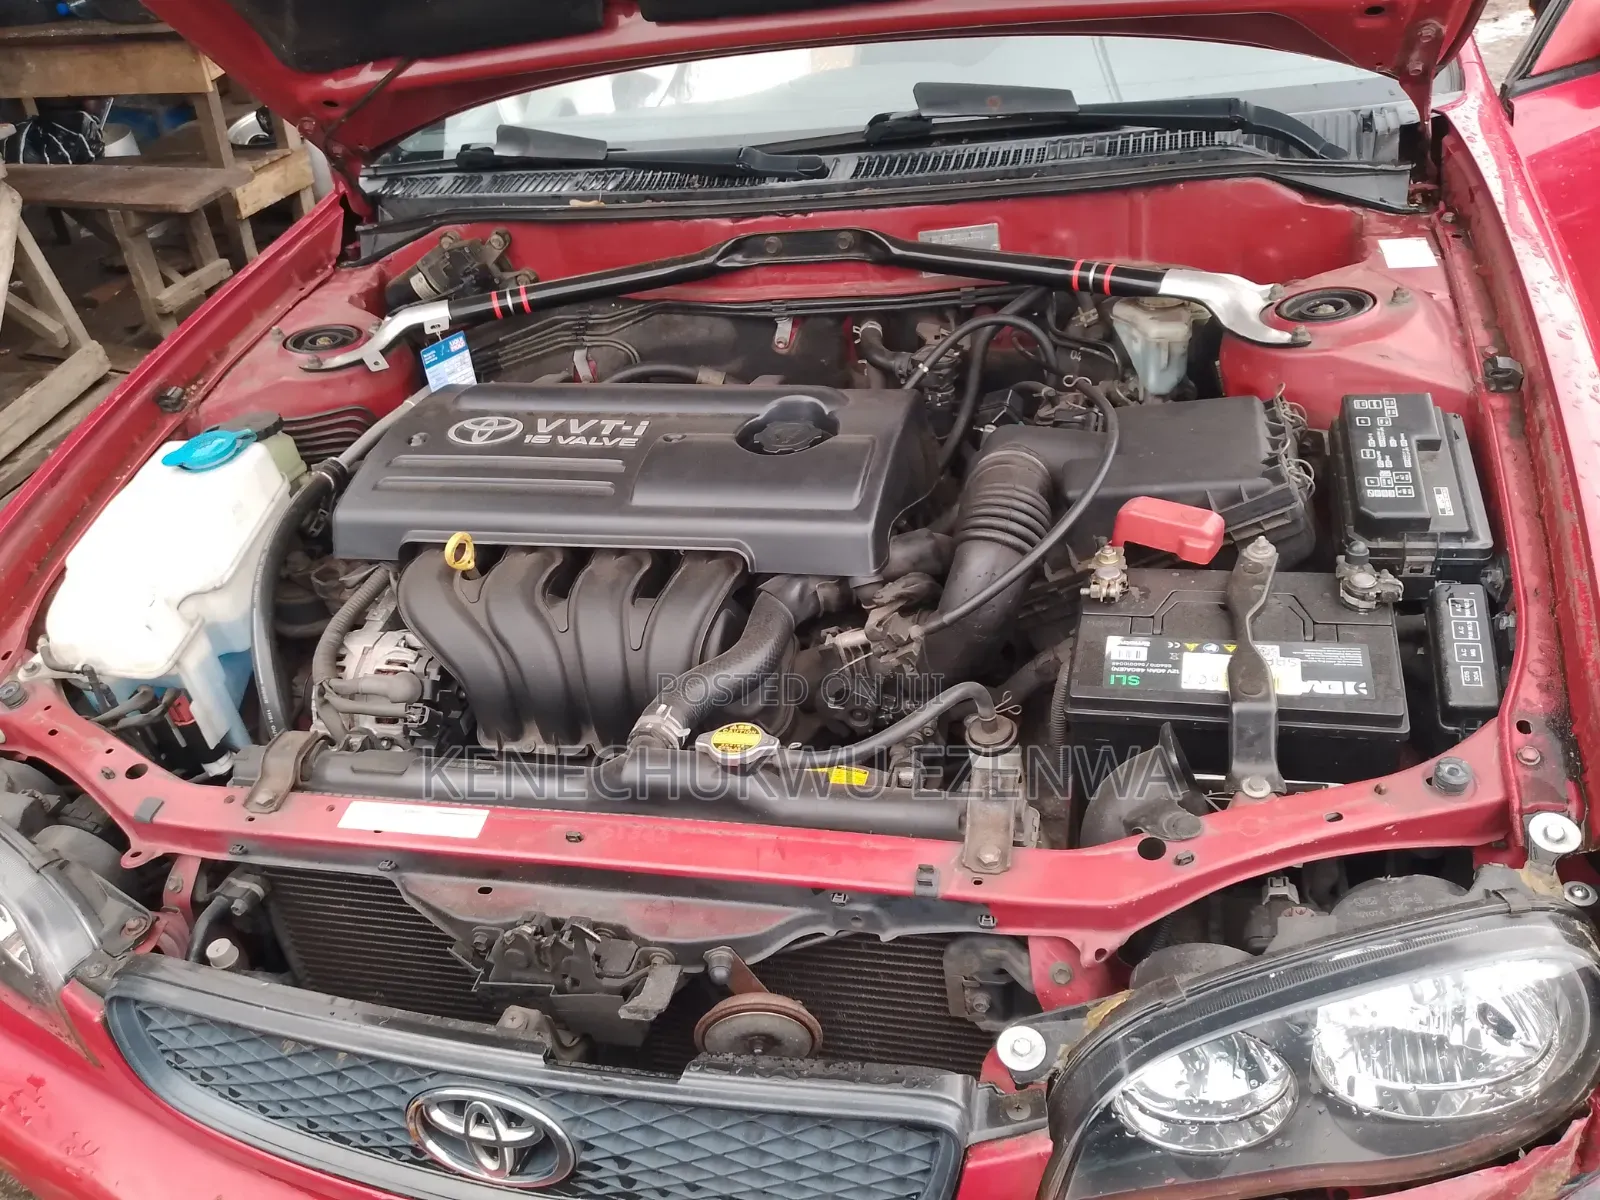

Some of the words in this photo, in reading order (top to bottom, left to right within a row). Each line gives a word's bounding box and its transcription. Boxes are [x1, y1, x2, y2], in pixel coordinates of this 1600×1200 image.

[537, 418, 650, 436] VVT-i
[523, 434, 553, 444] 16
[557, 435, 639, 447] VALVE
[1109, 674, 1141, 686] SLI
